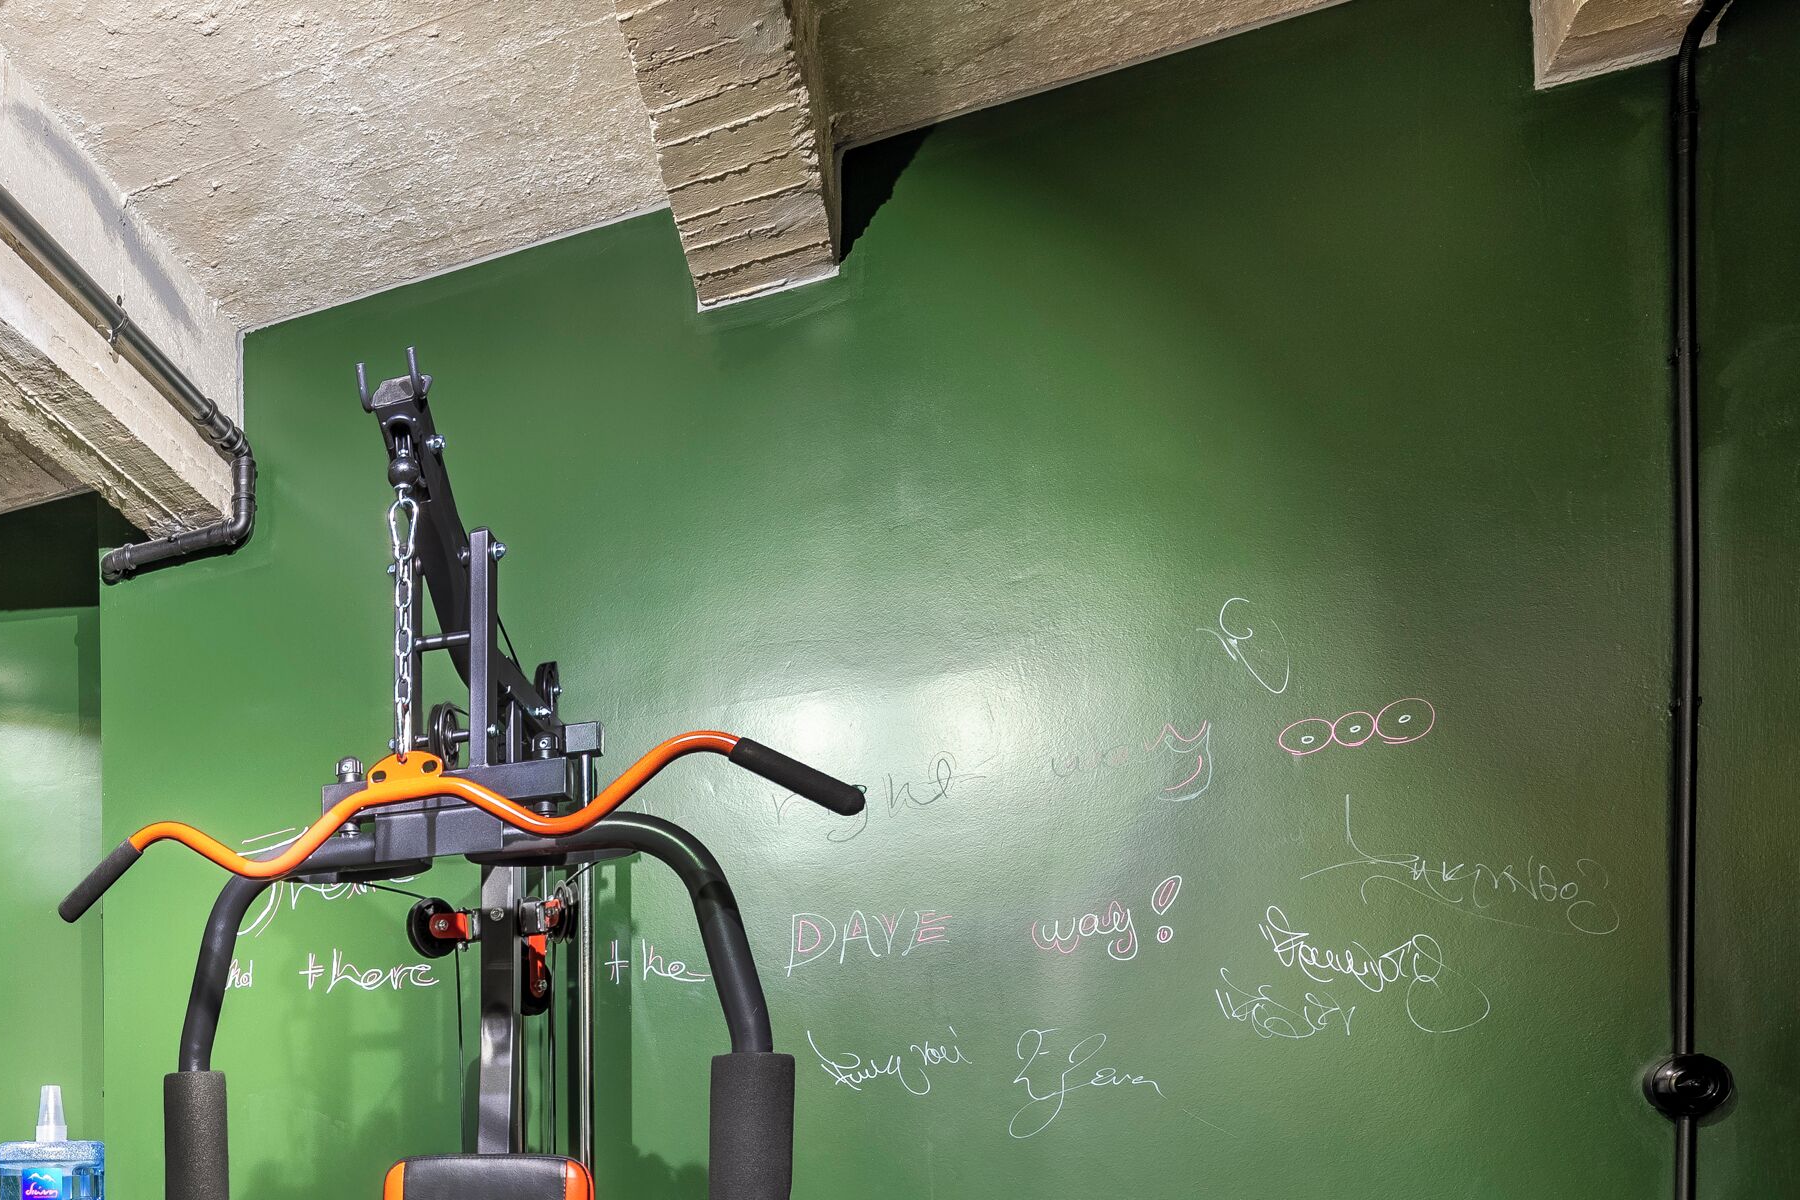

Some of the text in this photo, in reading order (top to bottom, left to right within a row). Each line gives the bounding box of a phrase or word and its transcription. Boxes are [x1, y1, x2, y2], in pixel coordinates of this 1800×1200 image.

[298, 947, 441, 994] there
[604, 938, 712, 985] the
[784, 907, 953, 978] DAVE
[1031, 874, 1183, 961] way!
